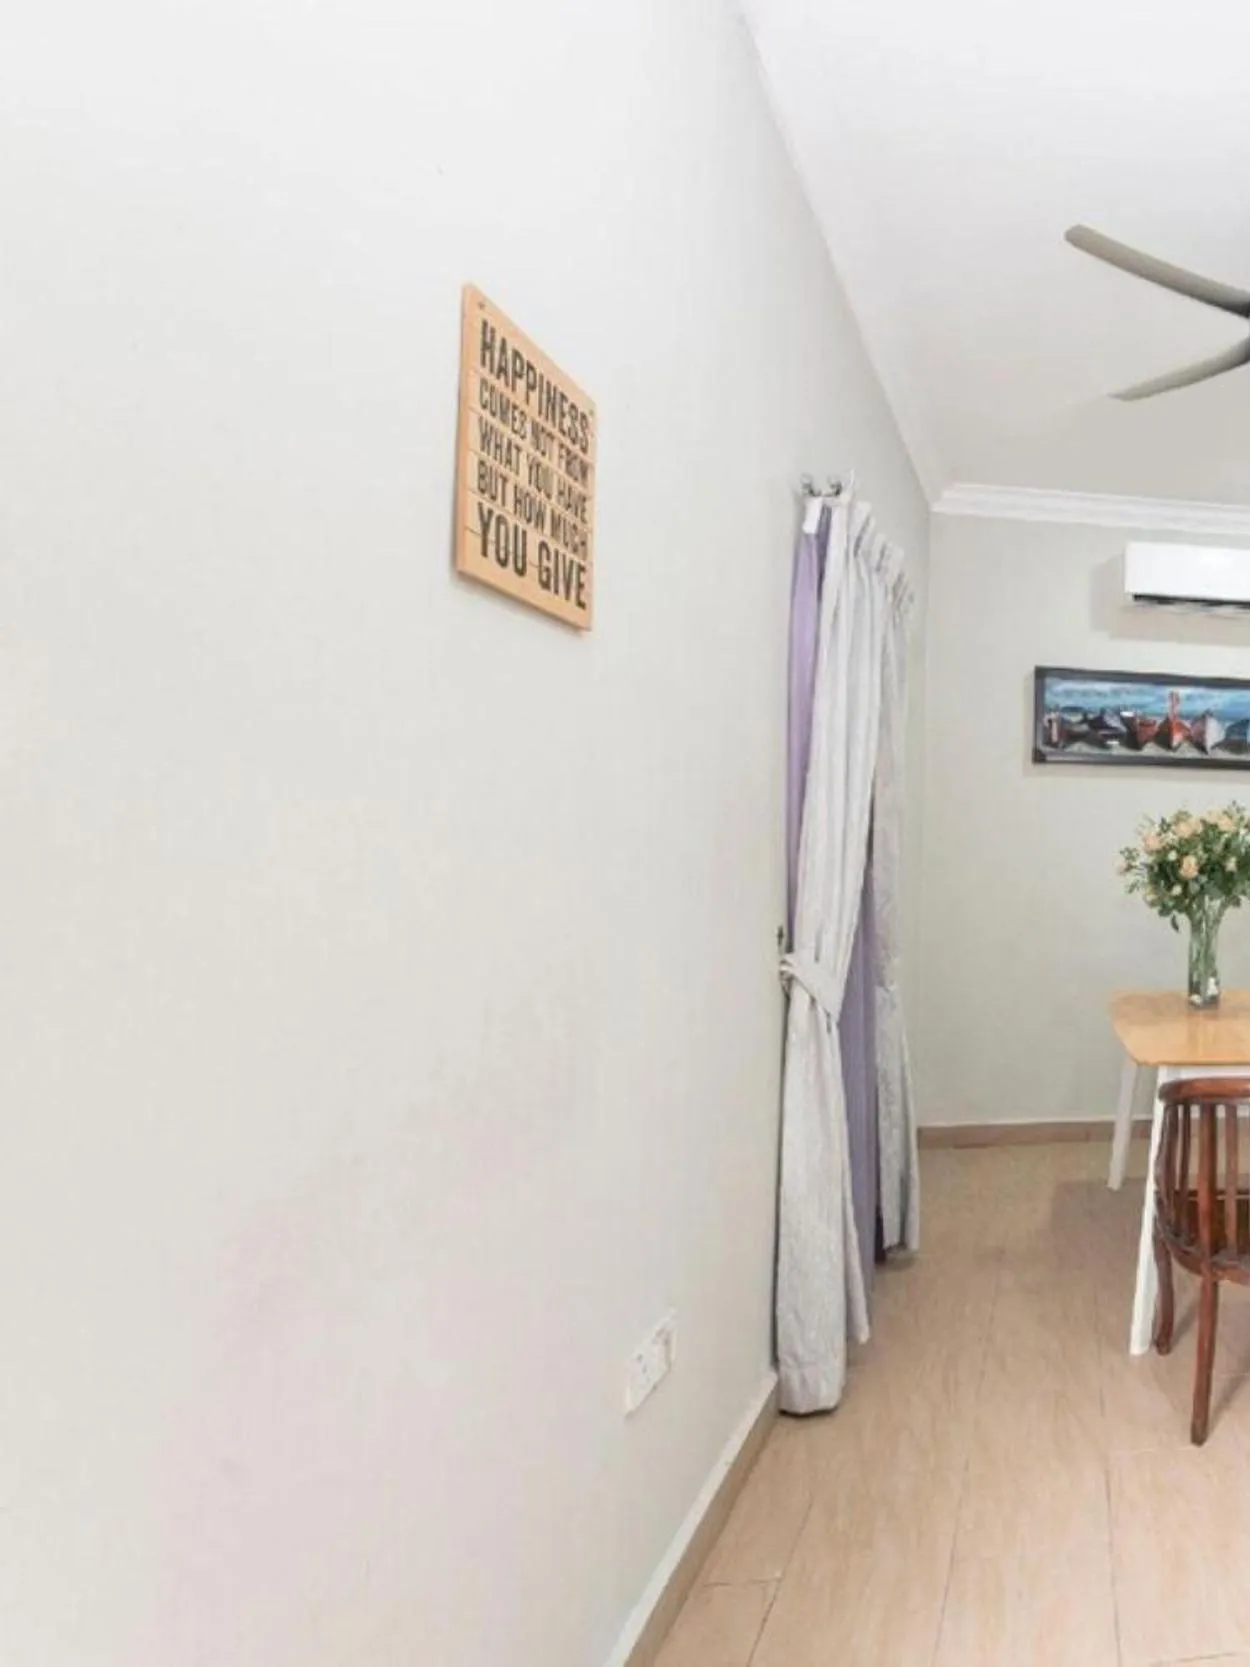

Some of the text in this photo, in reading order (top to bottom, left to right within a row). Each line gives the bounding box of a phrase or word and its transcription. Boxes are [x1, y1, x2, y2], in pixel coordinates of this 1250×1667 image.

[478, 377, 527, 441] COMES
[480, 318, 589, 454] HAPPINESS
[477, 459, 588, 561] BUT HOW MUCH
[478, 414, 588, 525] WHAT YOU HAVE
[478, 501, 587, 610] YOU GIVE
